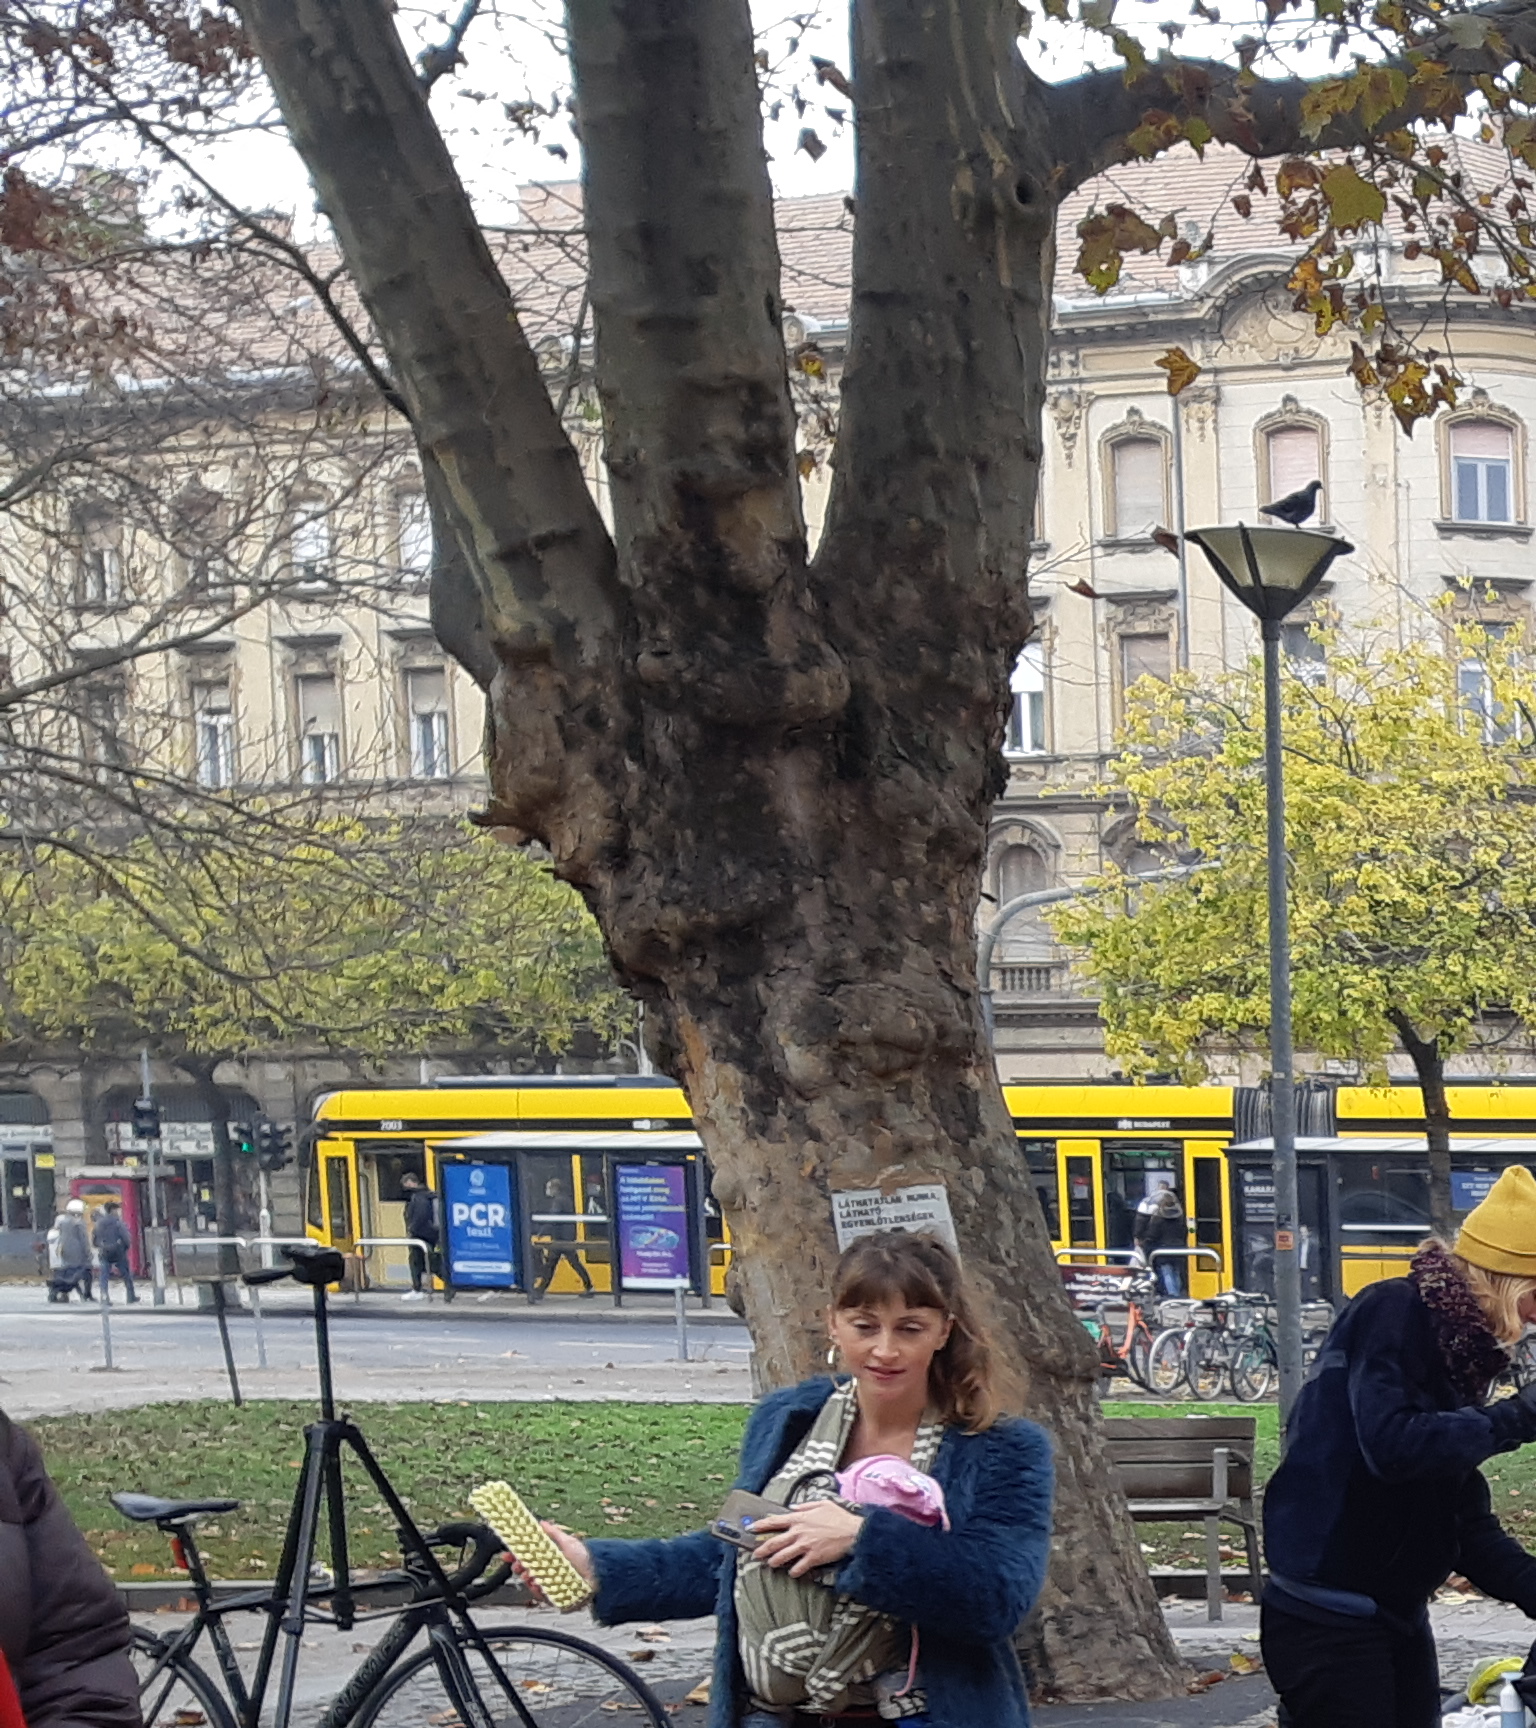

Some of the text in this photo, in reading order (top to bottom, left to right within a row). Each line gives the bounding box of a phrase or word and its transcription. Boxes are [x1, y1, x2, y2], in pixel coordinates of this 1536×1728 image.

[838, 1194, 903, 1209] LÁTHATATLAN
[452, 1202, 506, 1228] PCR
[839, 1205, 882, 1219] LÁTHATÓ
